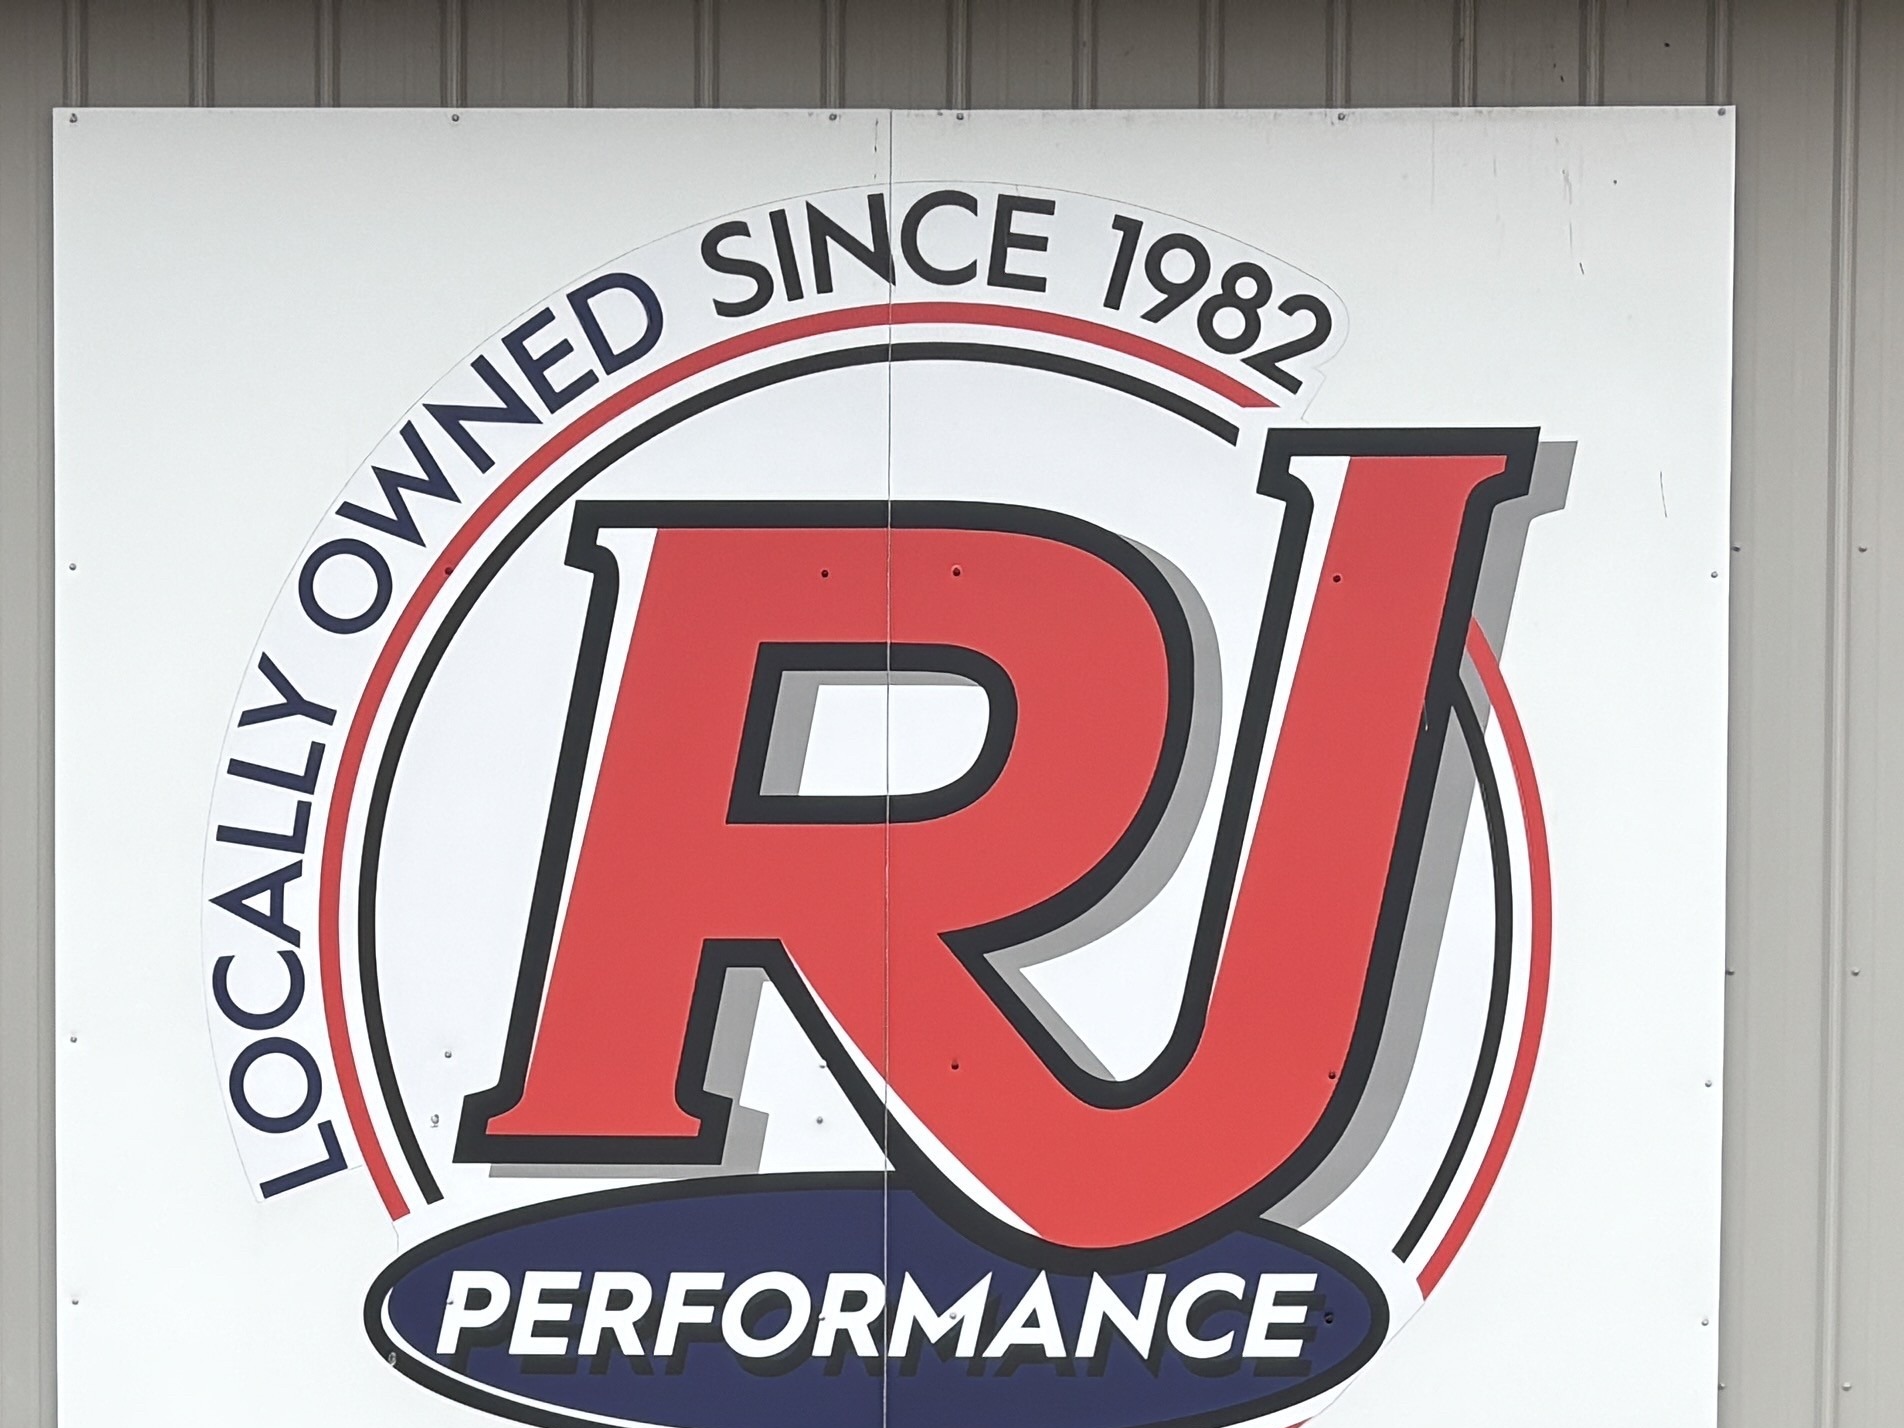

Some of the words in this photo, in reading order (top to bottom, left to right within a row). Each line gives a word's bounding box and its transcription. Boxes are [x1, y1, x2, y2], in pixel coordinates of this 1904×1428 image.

[209, 652, 347, 1198] LOCALLY
[299, 273, 663, 634] OWNED
[701, 190, 1055, 317] SINCE
[1104, 215, 1331, 394] 1982
[453, 426, 1540, 1272] RJ
[437, 1270, 1317, 1359] PERFORMANCE
